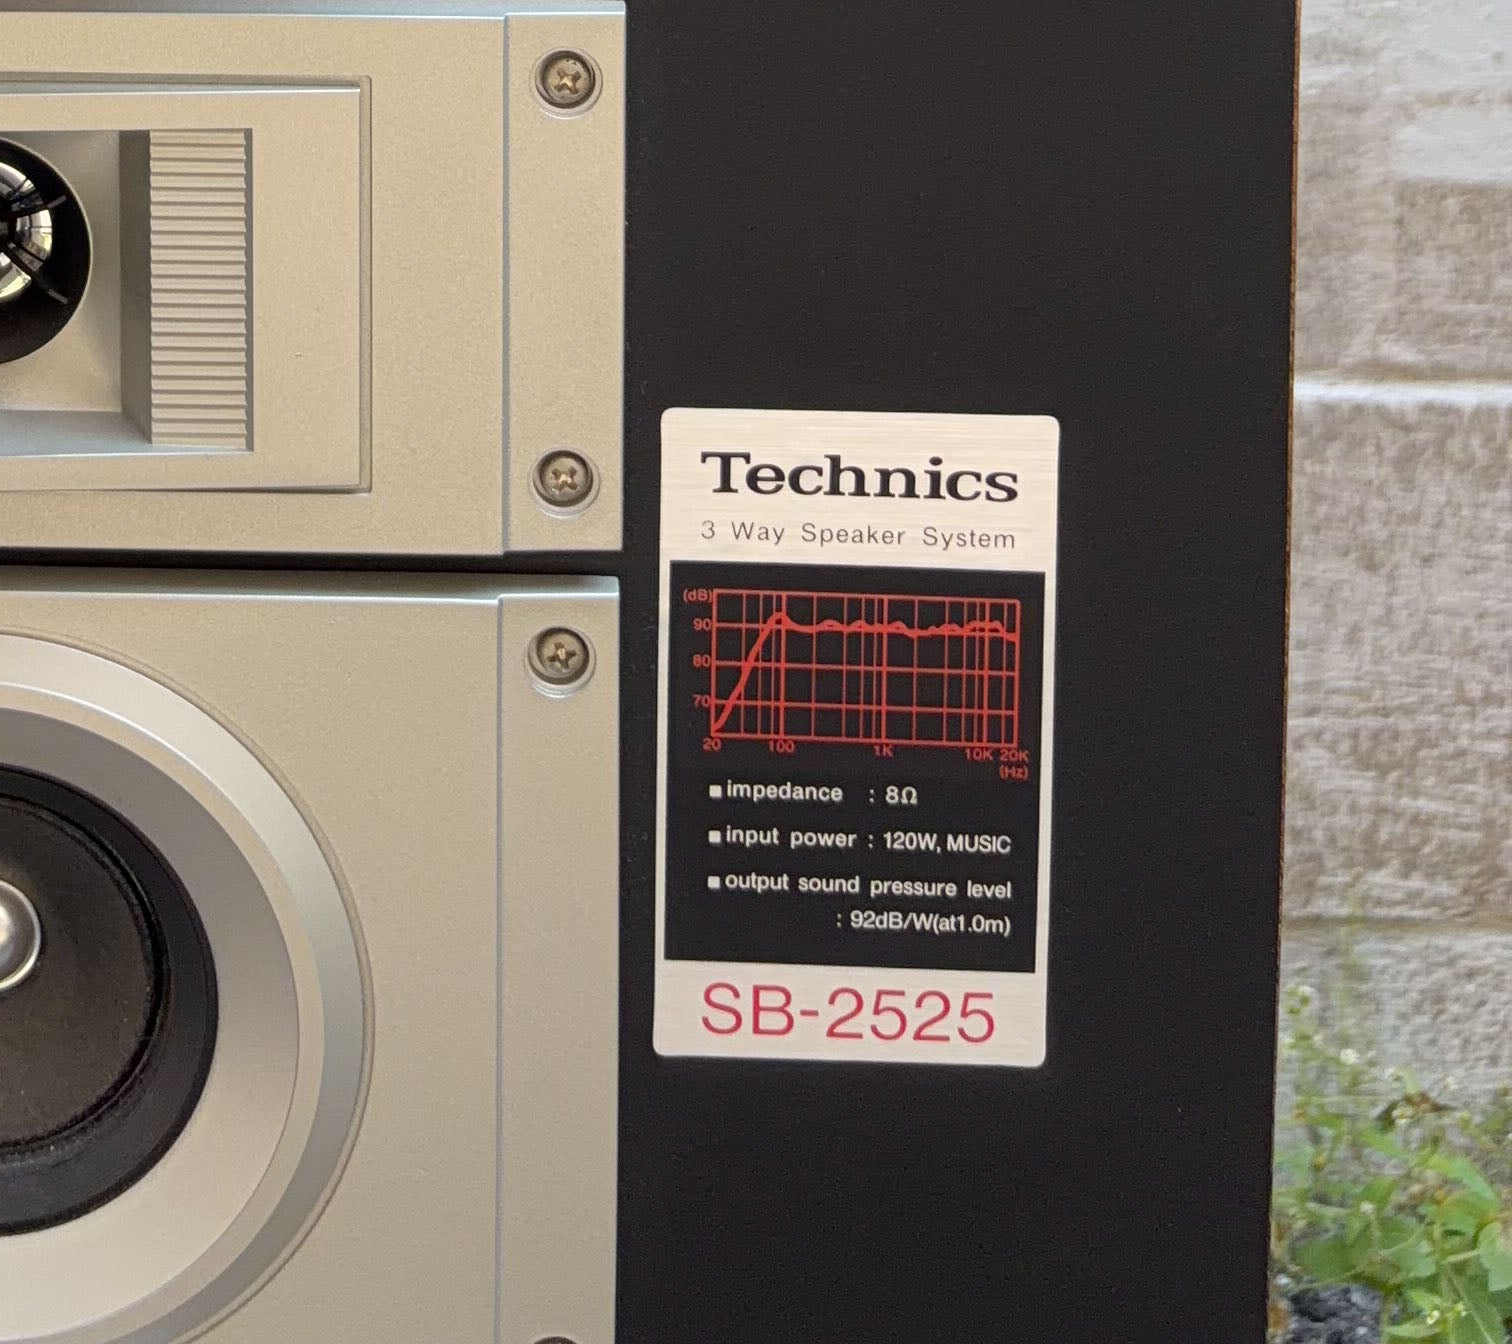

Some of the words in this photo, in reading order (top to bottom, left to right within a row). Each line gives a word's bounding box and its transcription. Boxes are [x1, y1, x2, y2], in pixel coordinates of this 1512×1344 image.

[701, 451, 1018, 502] Technics
[701, 521, 715, 540] 3
[731, 521, 785, 545] Way
[801, 523, 907, 547] Speaker
[923, 527, 1015, 550] System
[683, 588, 713, 603] (dB)
[694, 618, 711, 632] 90
[693, 654, 711, 669] 80
[693, 694, 711, 708] 70
[703, 738, 721, 752] 20
[768, 739, 794, 753] 100
[874, 743, 893, 757] 1K
[965, 748, 992, 761] 10K
[1000, 749, 1029, 762] 20K
[999, 764, 1029, 781] (Hz)
[727, 780, 843, 802] impedance
[726, 825, 779, 847] input
[790, 830, 857, 849] power
[884, 831, 942, 854] 120W,
[947, 833, 1011, 853] MUSIC
[725, 871, 789, 892] output
[799, 875, 860, 894] sound
[870, 879, 957, 898] pressure
[967, 879, 1011, 899] level
[850, 911, 1011, 936] 92dB/W(at1.0m)
[701, 982, 995, 1043] SB-2525
